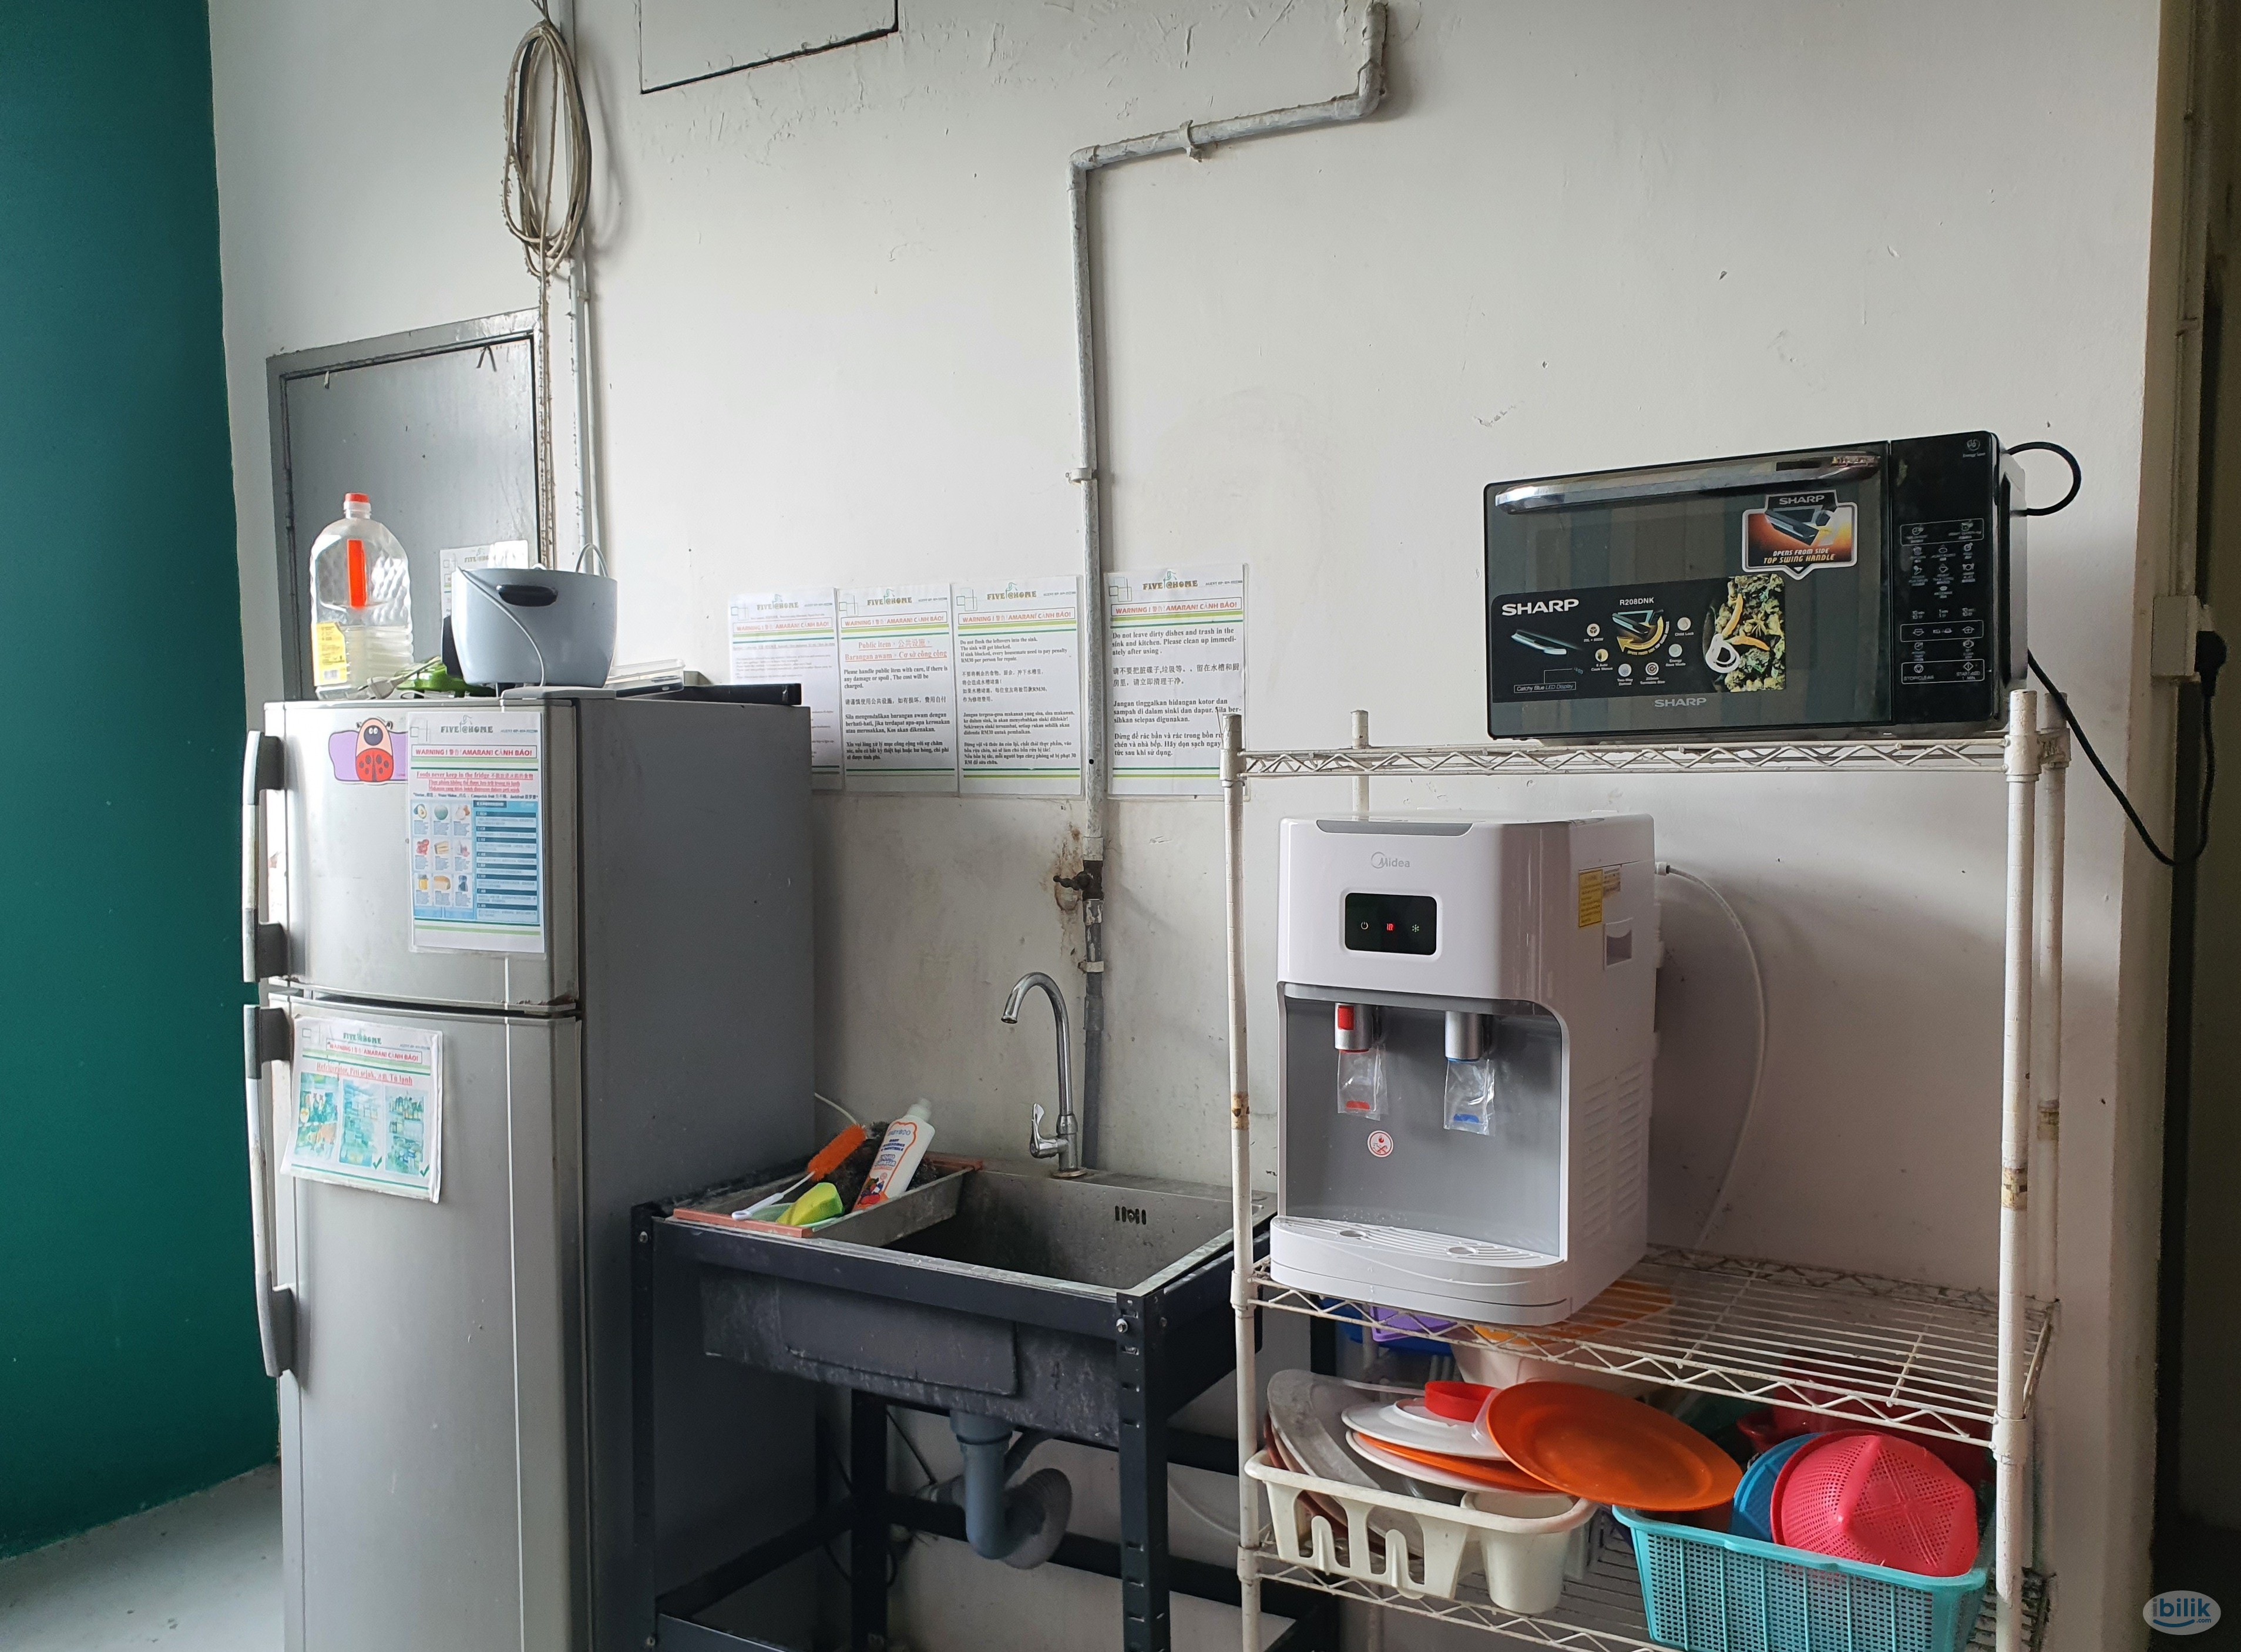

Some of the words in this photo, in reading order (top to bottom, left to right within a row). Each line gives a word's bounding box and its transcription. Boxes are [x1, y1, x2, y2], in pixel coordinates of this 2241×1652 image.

[1779, 495, 1825, 505] SHARP
[1779, 555, 1803, 563] SWING
[1806, 553, 1836, 562] HANDLE
[1619, 597, 1655, 606] R208DNK
[1116, 605, 1147, 613] WARNING
[1501, 599, 1580, 616] SHARP
[845, 653, 873, 662] Barangan
[1654, 697, 1707, 707] SHARP
[1373, 855, 1410, 868] Midea
